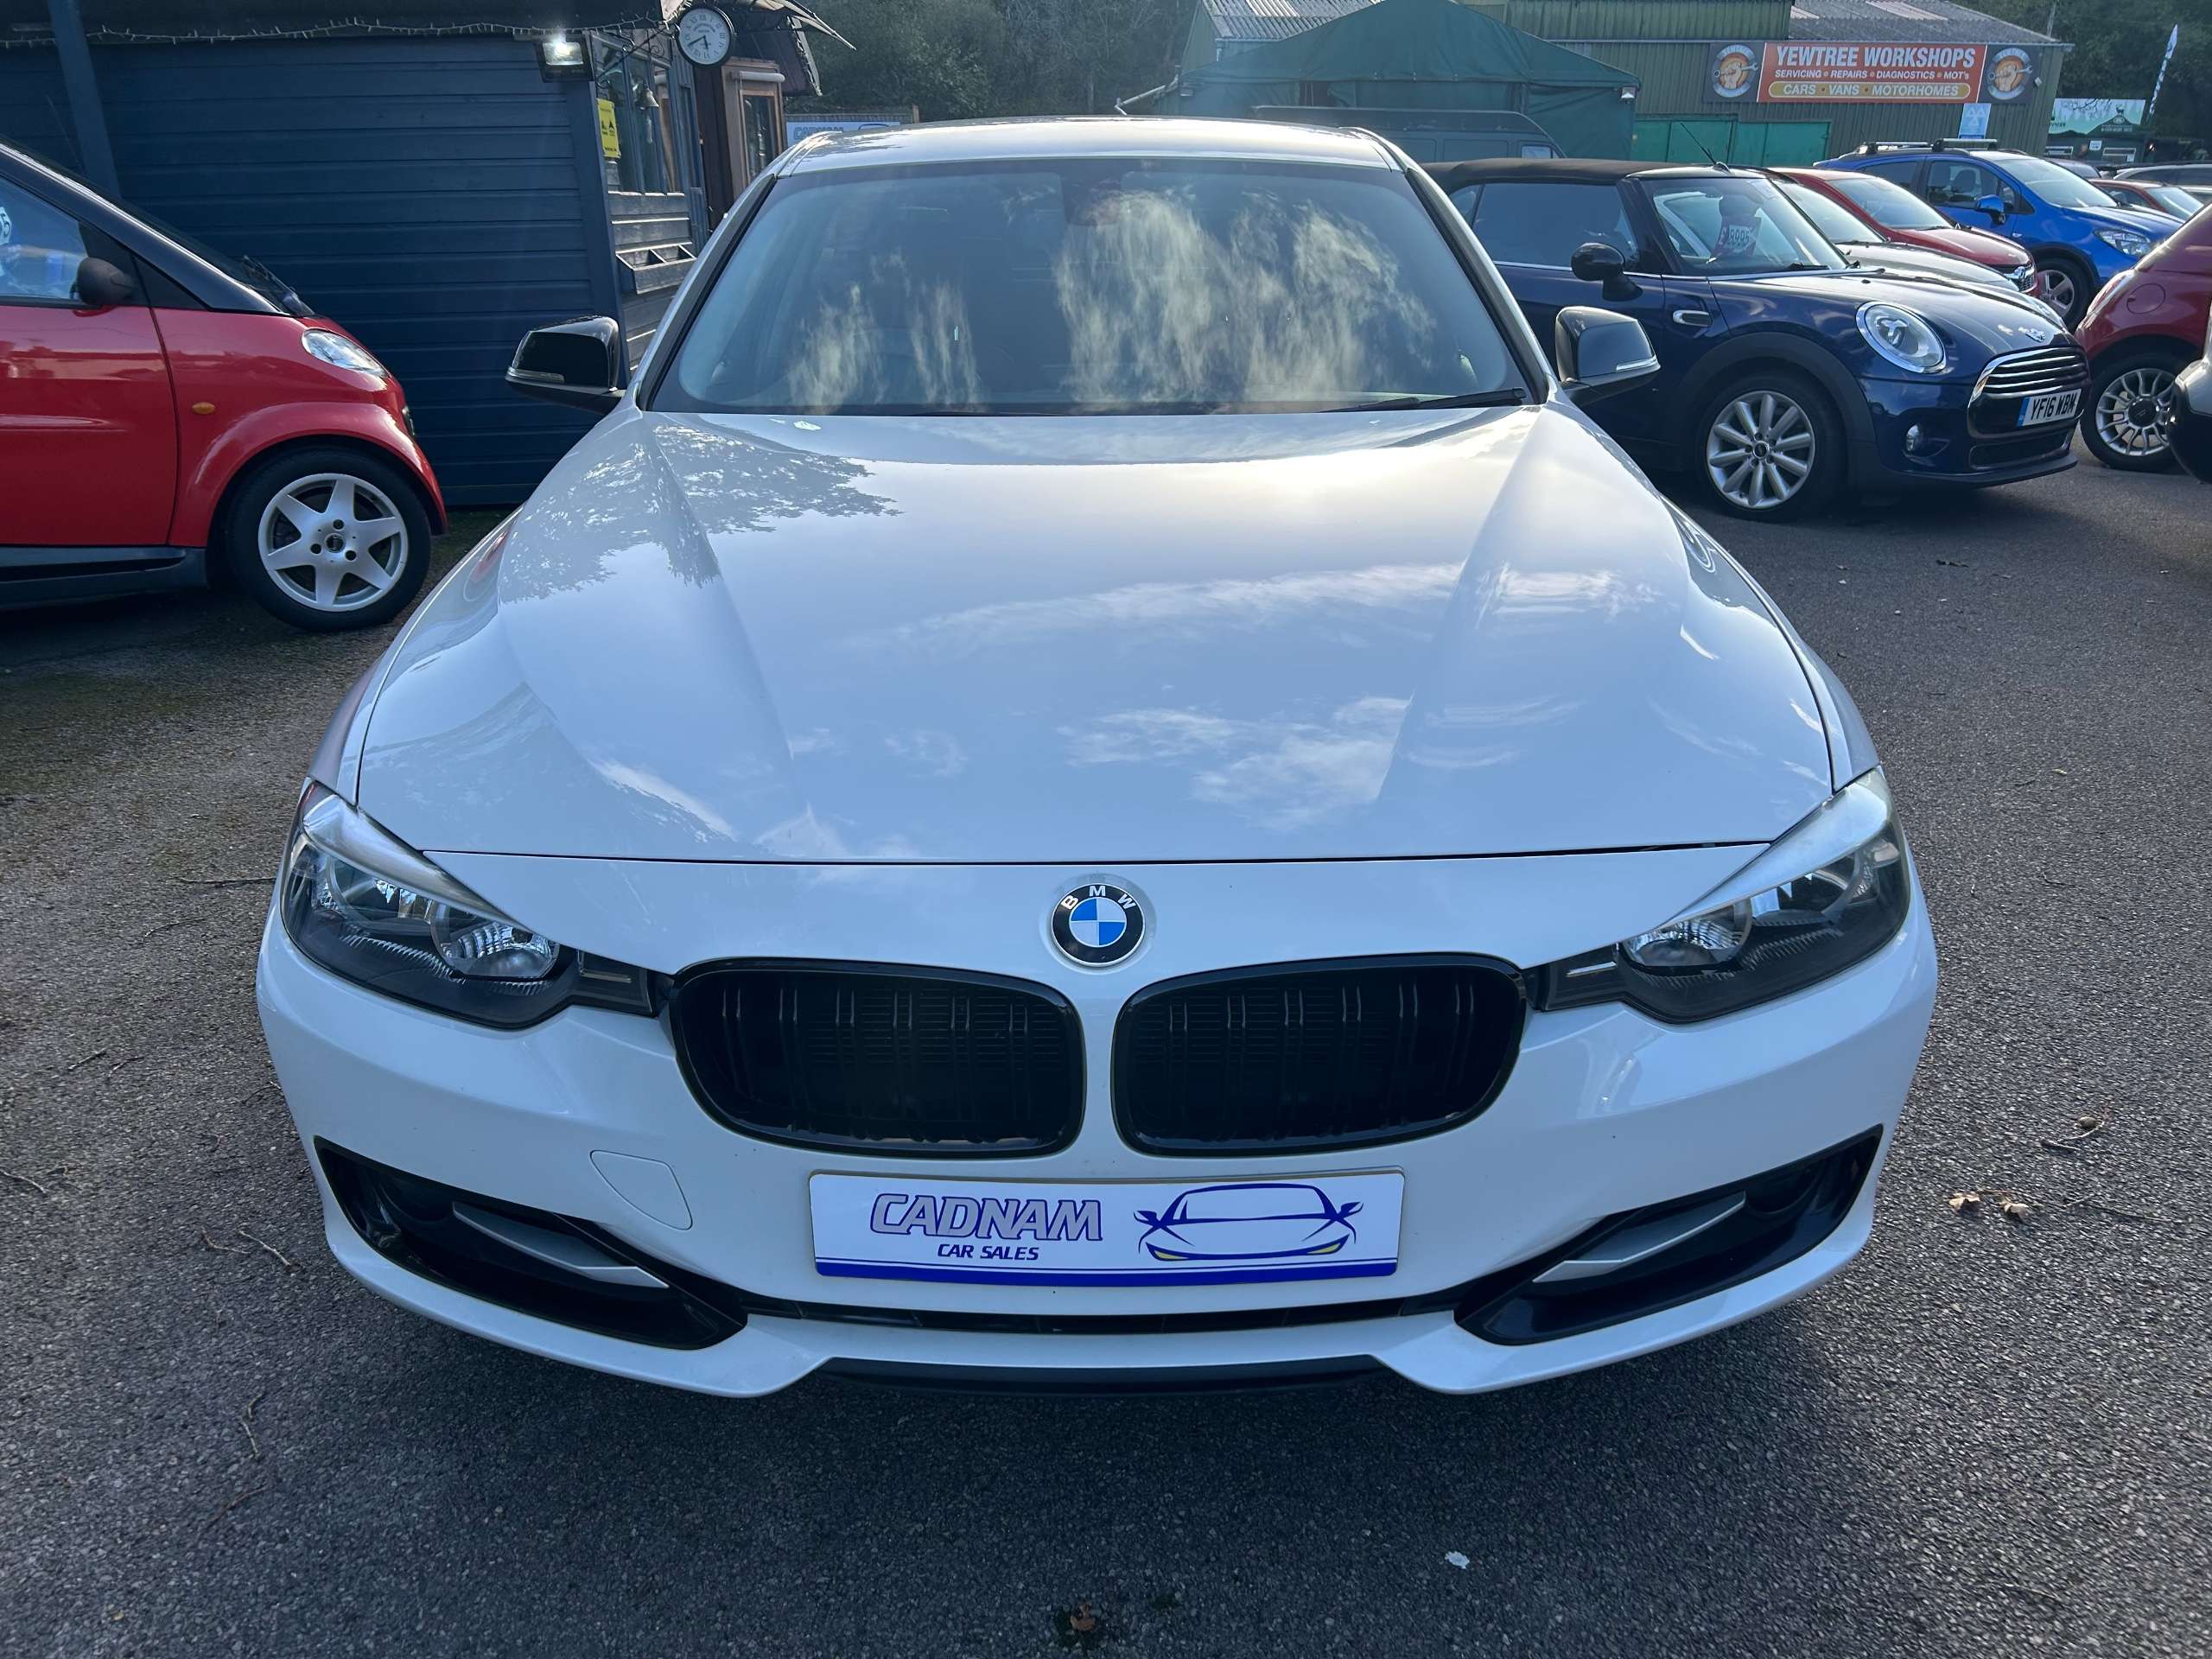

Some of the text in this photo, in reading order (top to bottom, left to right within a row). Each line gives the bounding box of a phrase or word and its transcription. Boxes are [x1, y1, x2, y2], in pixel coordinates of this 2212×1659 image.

[1777, 46, 1859, 67] YEWTREE
[1864, 47, 1976, 68] WORKSHOPS
[1775, 69, 1970, 80] SERVICING REPAIRS DIAGNOSTICS MOT's
[1783, 84, 1960, 97] CARS VANS MOTORHOMES
[2031, 396, 2057, 421] YF16
[1061, 885, 1137, 910] BMW
[870, 1193, 1103, 1242] CADNAM
[938, 1243, 1039, 1261] CAR SALES
